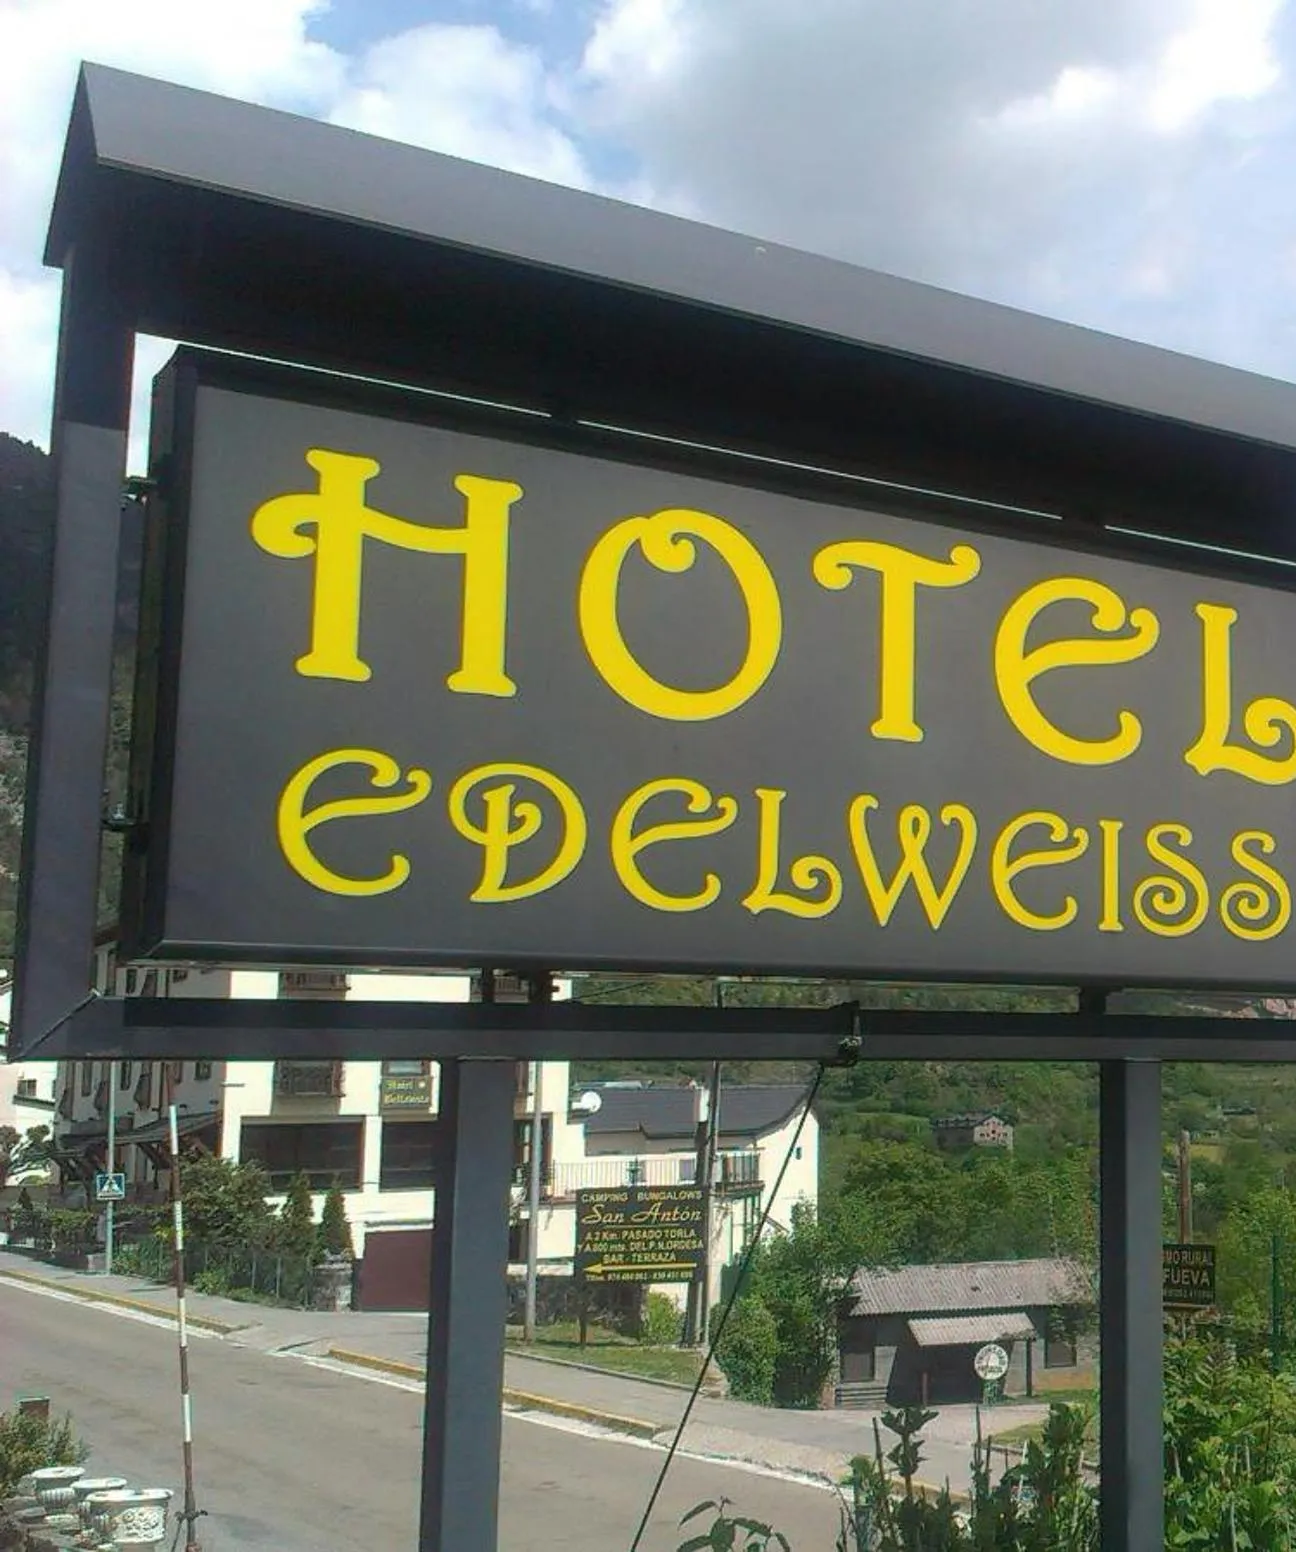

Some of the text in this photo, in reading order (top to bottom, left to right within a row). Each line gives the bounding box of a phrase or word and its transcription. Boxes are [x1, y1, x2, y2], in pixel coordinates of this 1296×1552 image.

[278, 749, 1292, 941] EDELWEISS
[581, 1190, 702, 1203] CAMPING BUNGALOWS
[581, 1202, 702, 1224] San Antón
[621, 1230, 662, 1241] PASADO
[663, 1228, 696, 1239] TORLA
[603, 1252, 677, 1264] BAR TERRAZA
